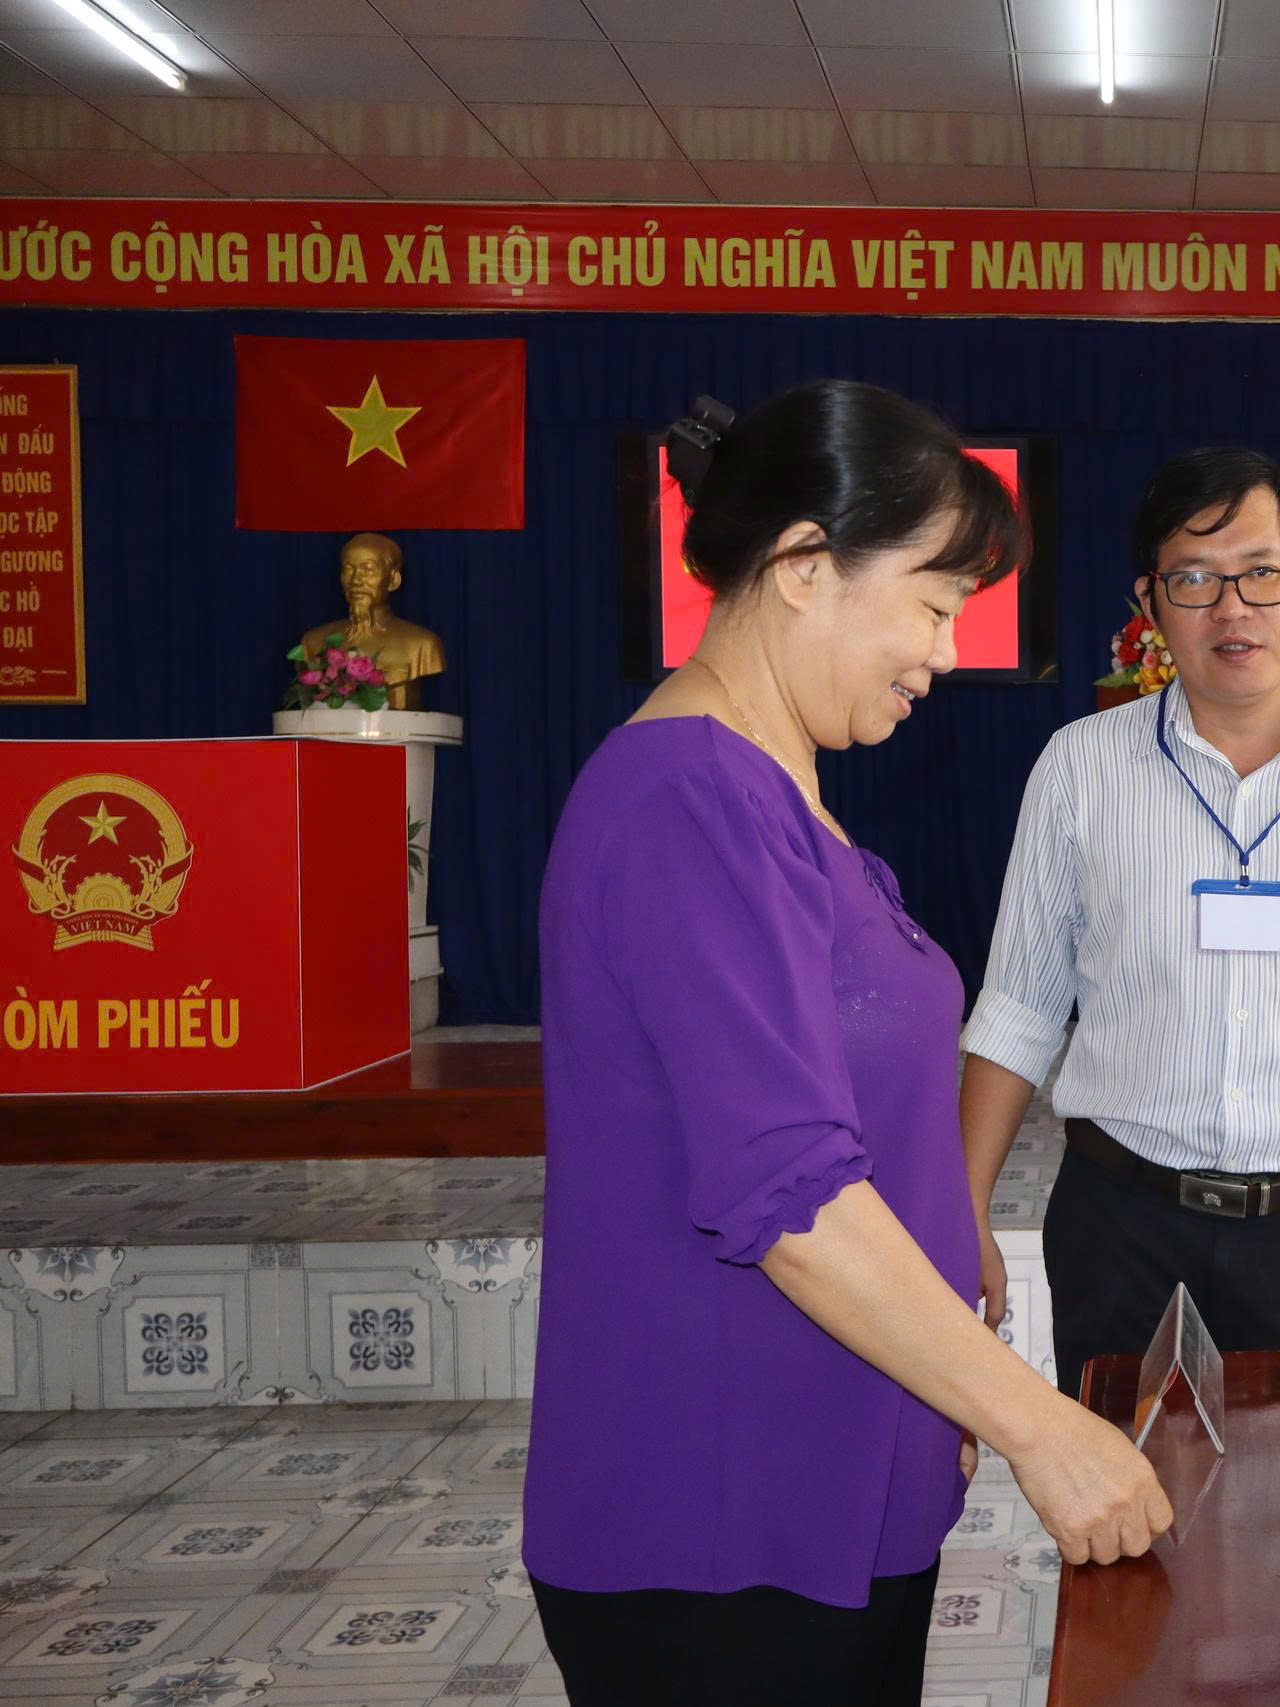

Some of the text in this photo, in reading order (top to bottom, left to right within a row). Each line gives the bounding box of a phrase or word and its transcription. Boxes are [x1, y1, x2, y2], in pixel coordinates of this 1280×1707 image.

[111, 221, 249, 293] CỘNG
[267, 221, 368, 284] HÒA
[384, 225, 452, 285] XÃ
[469, 225, 549, 296] HỘI
[568, 221, 666, 287] CHỦ
[684, 229, 837, 288] NGHĨA
[851, 230, 955, 300] VIỆT
[971, 241, 1084, 291] NAM
[1102, 233, 1247, 292] MUÔN
[2, 468, 52, 498] ĐỘNG
[25, 507, 59, 538] TẬP
[16, 581, 40, 612] HỒ
[3, 626, 33, 652] ĐẠI
[98, 979, 240, 1049] PHIẾU
